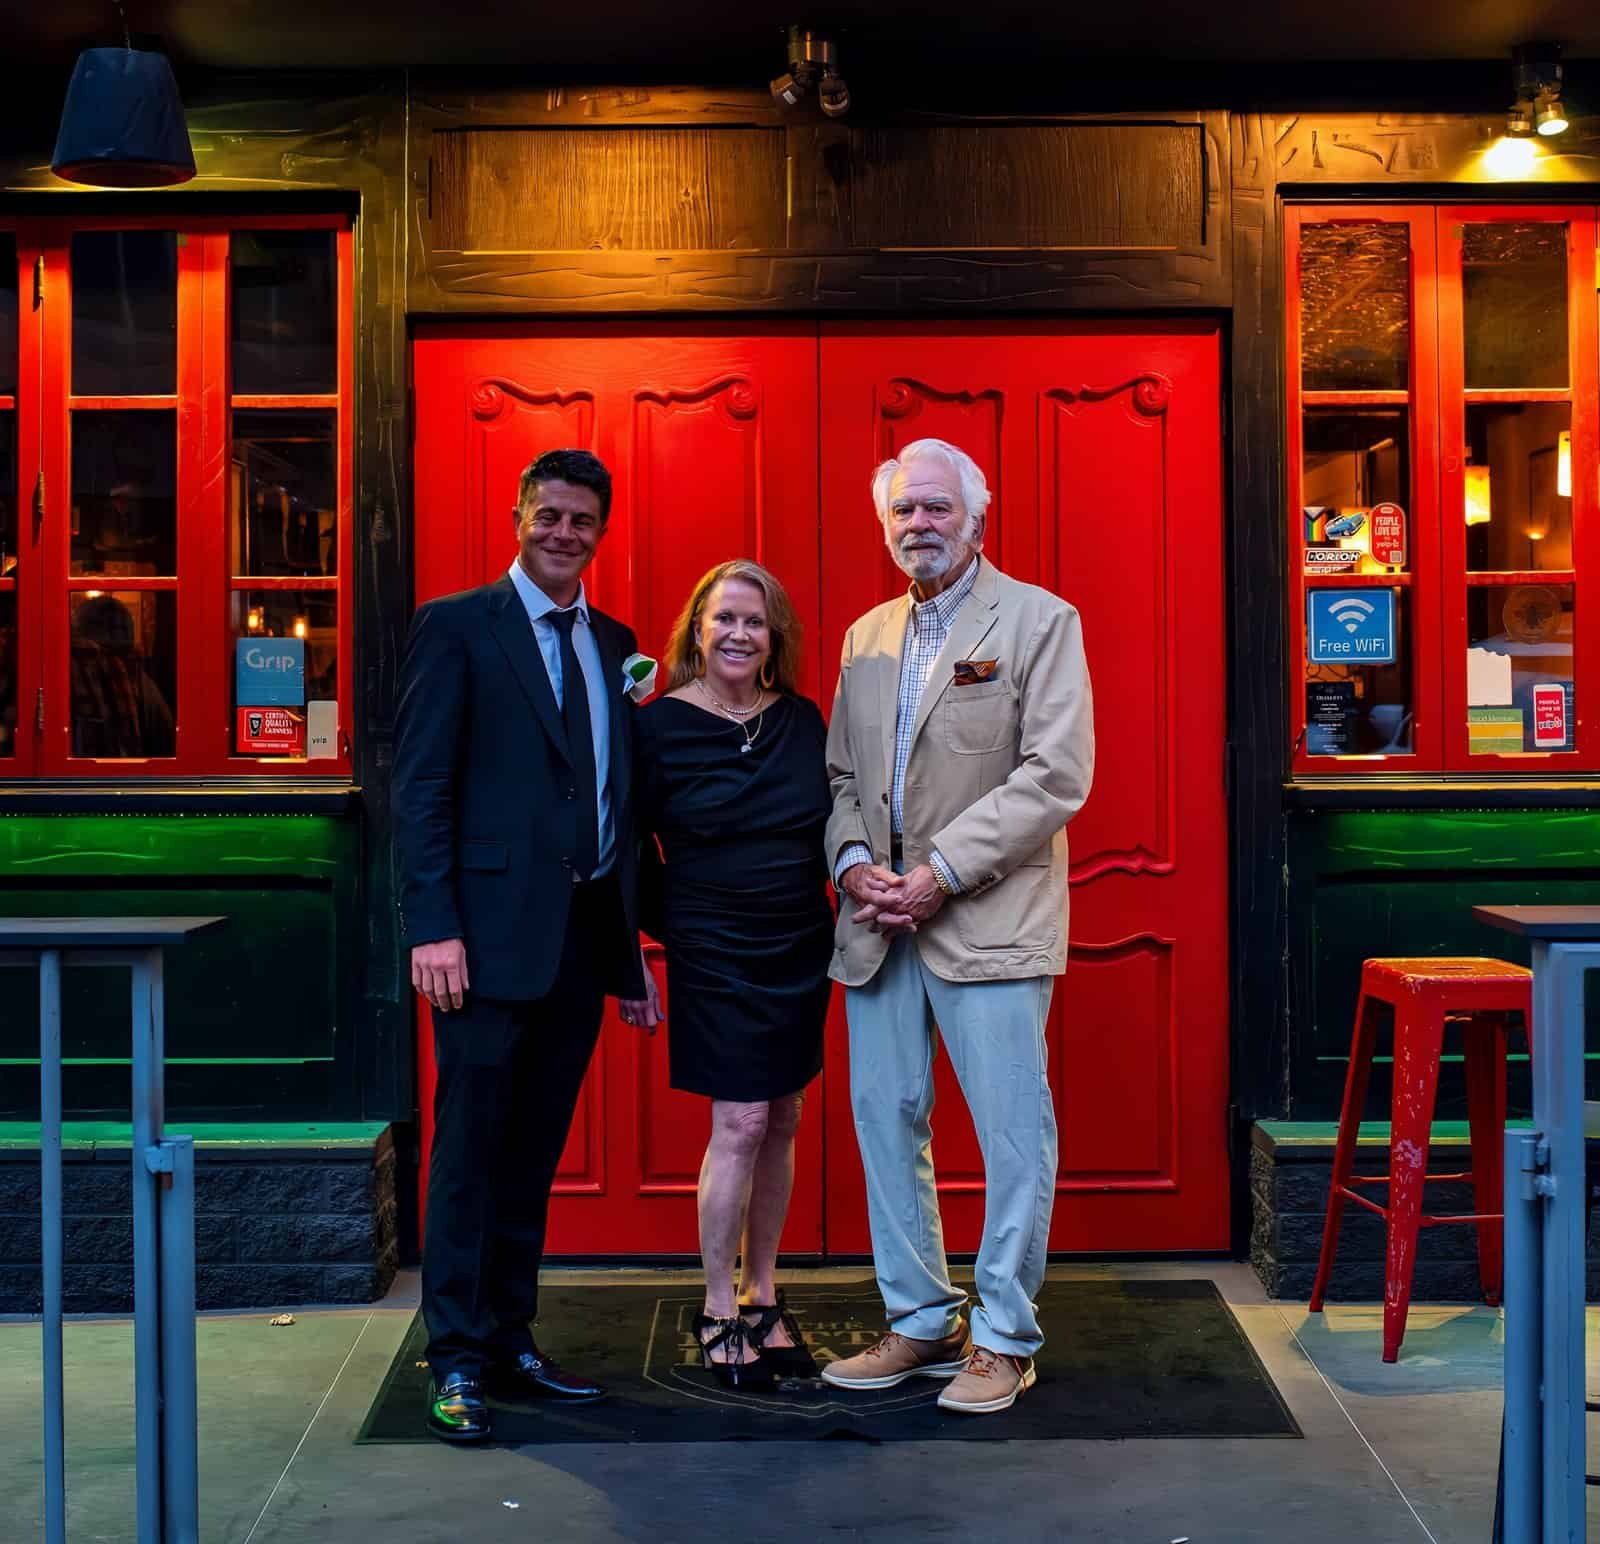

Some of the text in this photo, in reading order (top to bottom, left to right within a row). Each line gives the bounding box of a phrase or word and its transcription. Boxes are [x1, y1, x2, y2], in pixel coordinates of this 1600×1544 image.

[1376, 516, 1399, 526] PEOPLE
[1374, 526, 1389, 536] LOVE
[1319, 638, 1385, 653] Free WiFi
[246, 647, 296, 673] Grip
